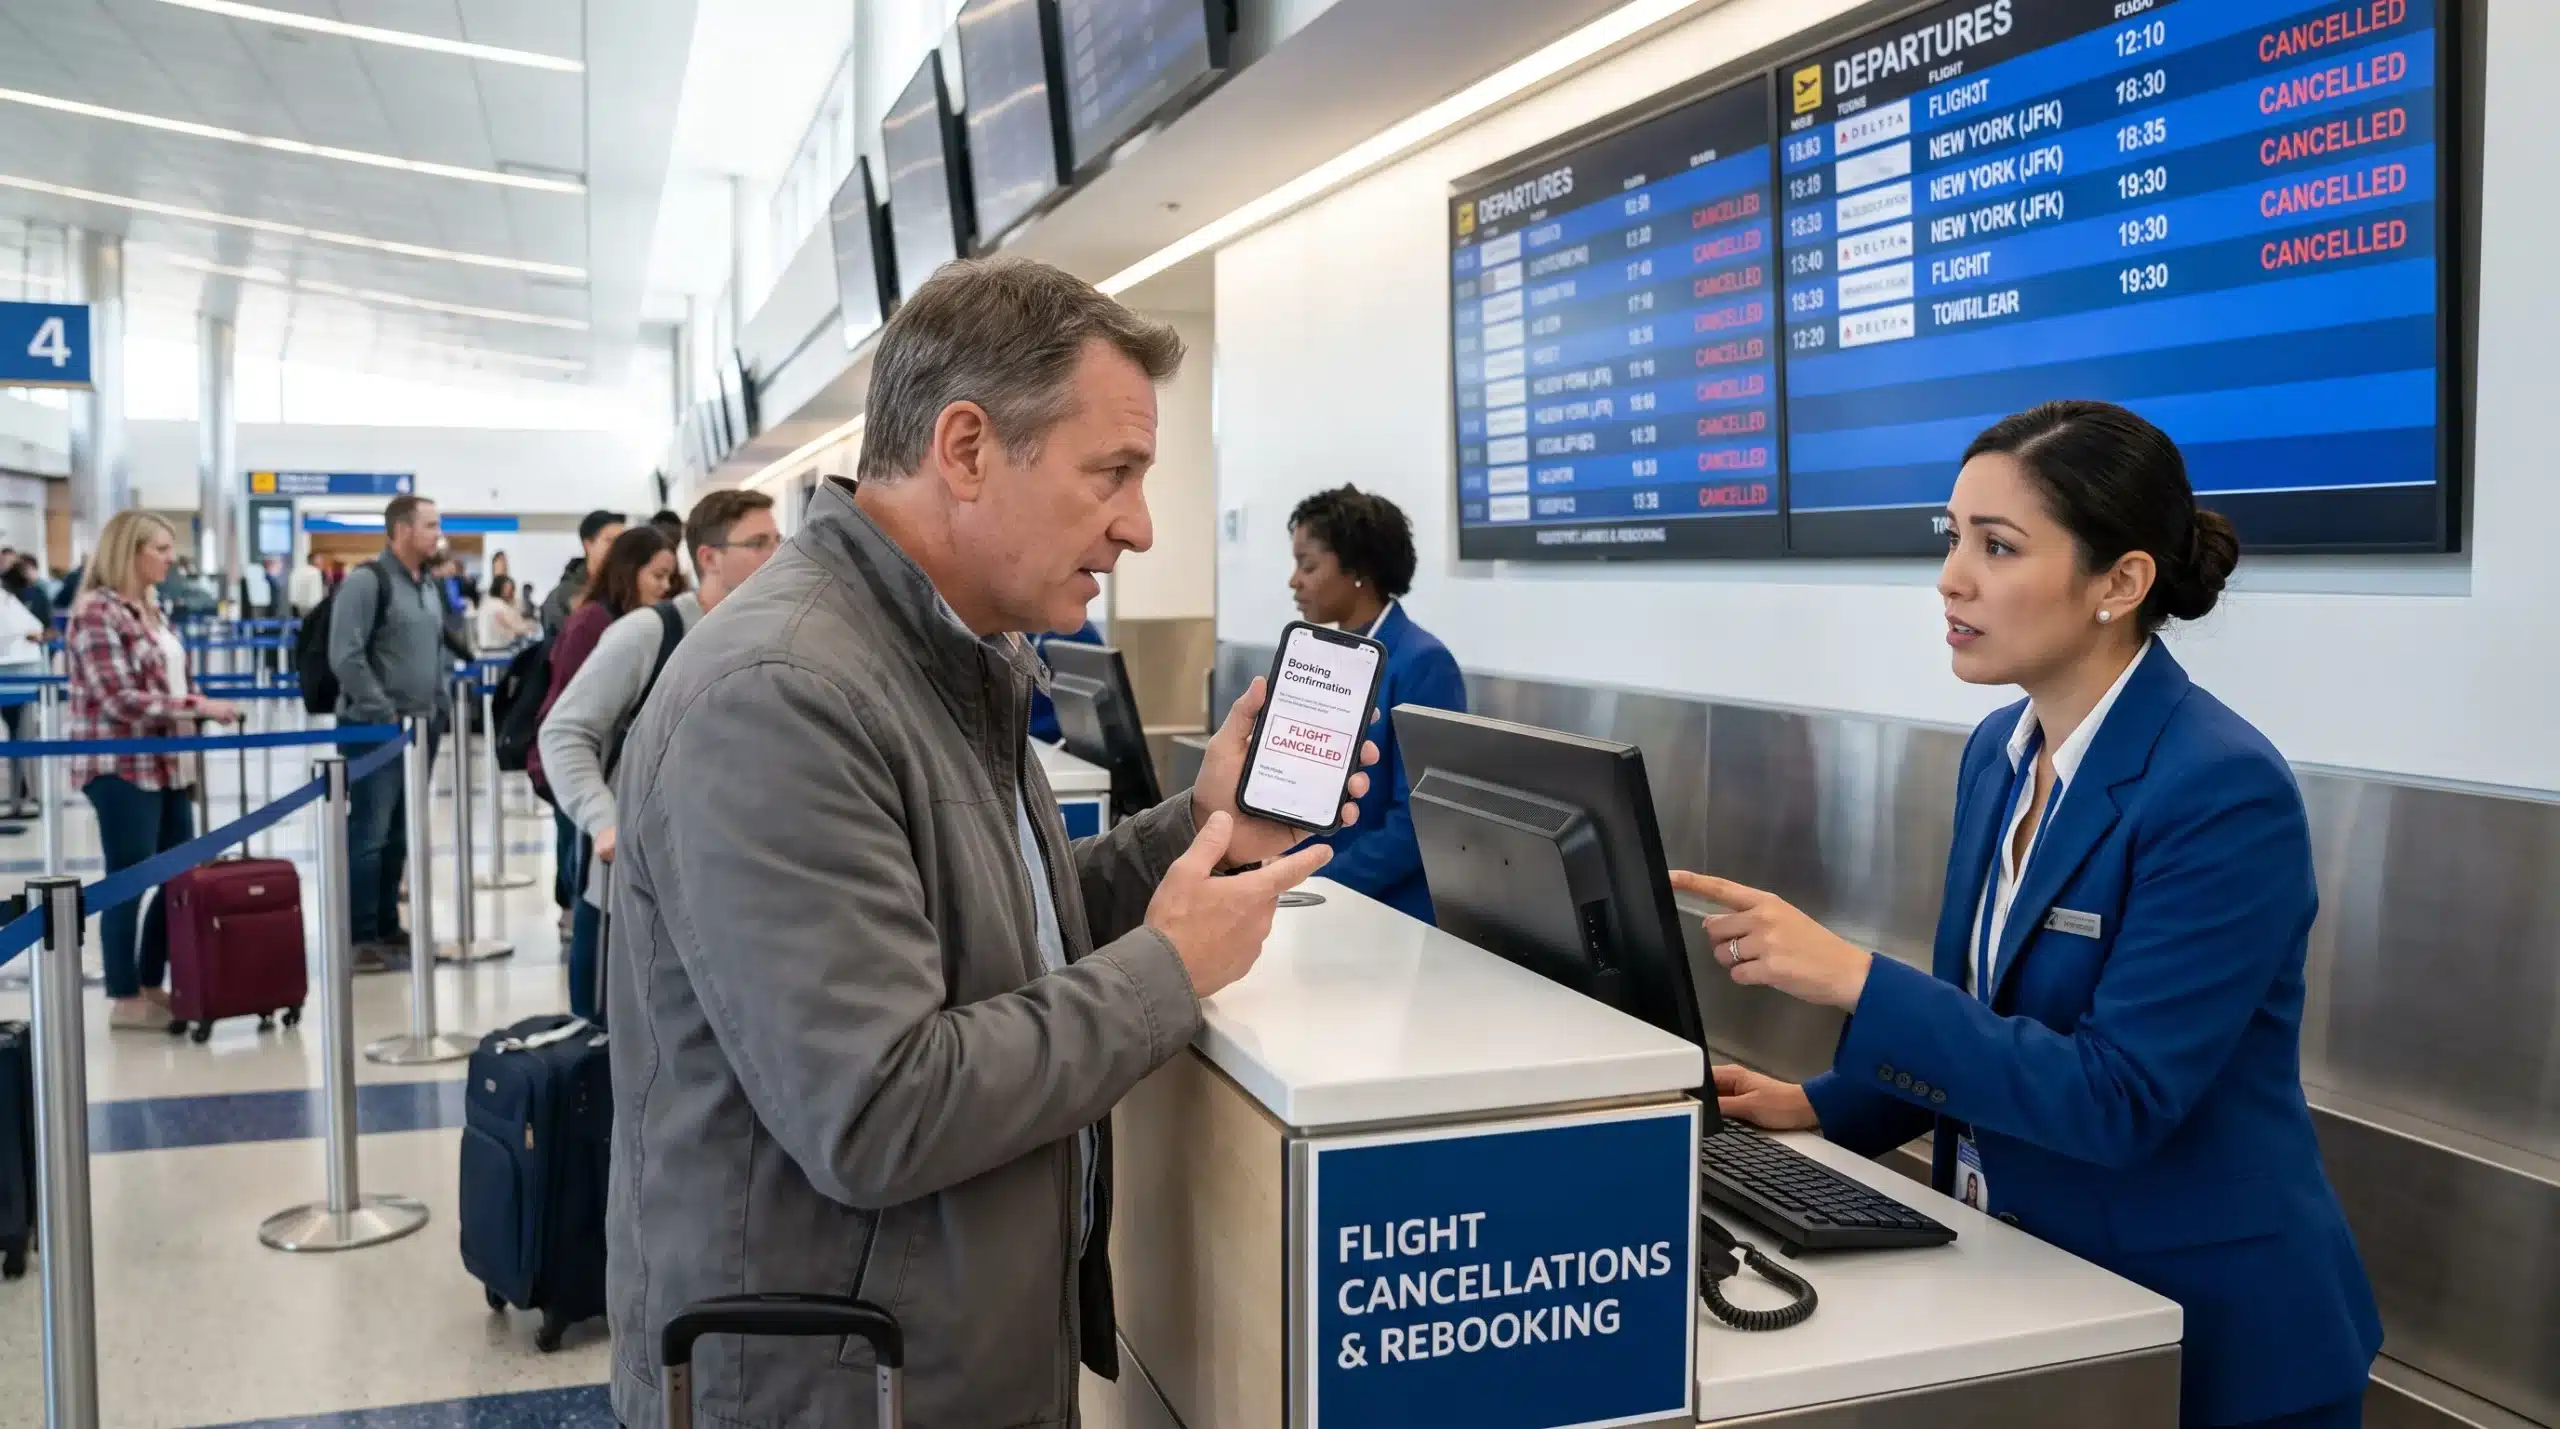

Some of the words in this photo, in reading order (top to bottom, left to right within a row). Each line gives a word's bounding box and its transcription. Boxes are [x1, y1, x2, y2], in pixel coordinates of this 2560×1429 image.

[1834, 0, 2013, 95] DEPARTURES
[2115, 20, 2165, 57] 12:10
[2259, 0, 2406, 62] CANCELLED
[1928, 60, 1964, 84] FLIGHT
[1929, 132, 1965, 161] NEW
[1967, 118, 2015, 153] YORK
[2018, 99, 2063, 133] (JFK)
[2115, 69, 2165, 104] 18:30
[2259, 51, 2406, 114] CANCELLED
[1930, 173, 1965, 203] NEW
[1969, 161, 2015, 195] YORK
[2019, 144, 2063, 183] (JFK)
[2116, 117, 2166, 152] 18:35
[2260, 107, 2406, 166] CANCELLED
[1478, 166, 1573, 225] DEPARTURES
[1692, 193, 1760, 229] CANCELLED
[1931, 217, 1966, 244] NEW
[1969, 203, 2016, 235] YORK
[2020, 190, 2064, 227] (JFK)
[2117, 166, 2167, 199] 19:30
[2260, 163, 2407, 217] CANCELLED
[1693, 229, 1761, 263] CANCELLED
[2118, 214, 2168, 247] 19:30
[2261, 219, 2407, 270] CANCELLED
[1694, 266, 1762, 298] CANCELLED
[2119, 263, 2169, 294] 19:30
[1695, 303, 1763, 333] CANCELLED
[27, 316, 72, 368] 4
[1696, 339, 1764, 367] CANCELLED
[1697, 375, 1764, 401] CANCELLED
[1698, 411, 1765, 436] CANCELLED
[1698, 448, 1767, 471] CANCELLED
[1699, 484, 1768, 507] CANCELLED
[1284, 670, 1353, 696] Confirmation
[1288, 658, 1332, 679] Booking
[1271, 735, 1342, 763] CANCELLED
[1288, 725, 1332, 744] FLIGHT
[1339, 1211, 1486, 1263] FLIGHT
[1338, 1241, 1672, 1316] CANCELLATIONS
[1337, 1332, 1369, 1370] &
[1380, 1298, 1621, 1365] REBOOKING
